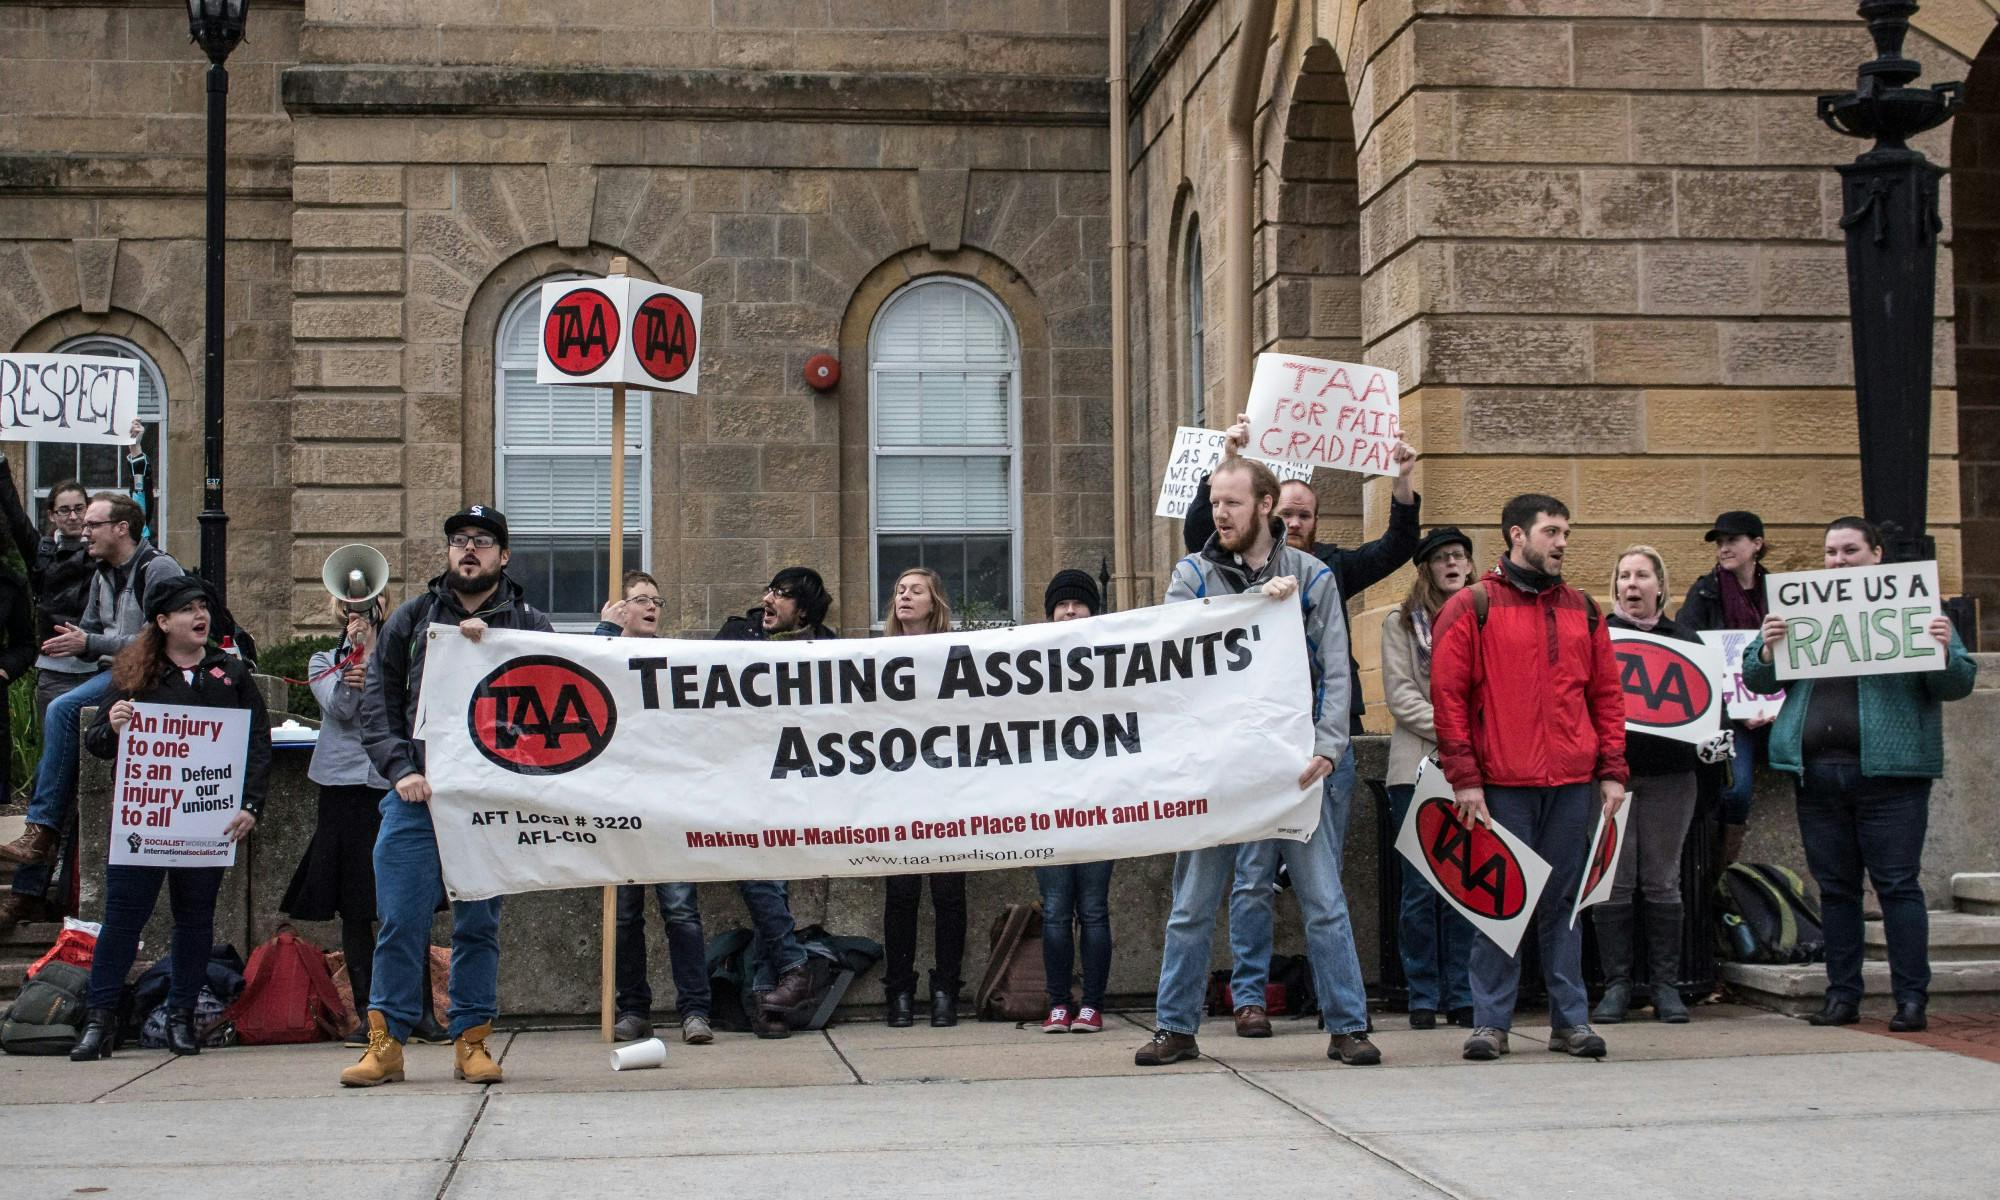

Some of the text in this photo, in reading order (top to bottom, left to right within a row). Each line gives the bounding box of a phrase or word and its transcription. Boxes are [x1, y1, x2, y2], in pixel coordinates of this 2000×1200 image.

[551, 303, 611, 359] TAA
[641, 306, 689, 367] TAA
[0, 359, 135, 437] RESPECT
[1283, 361, 1391, 406] TAA
[1272, 397, 1399, 439] FOR FAIR
[1176, 449, 1201, 465] AS
[1258, 427, 1398, 471] GRAD PAY
[1170, 467, 1188, 482] WE
[1779, 574, 1929, 606] GIVE US A
[1785, 606, 1935, 670] RAISE
[128, 711, 224, 742] An injury
[481, 683, 603, 749] TAA
[127, 735, 190, 759] to one
[124, 758, 172, 781] is an
[181, 764, 232, 783] Defend
[122, 781, 184, 810] injury
[182, 794, 234, 814] unions!
[195, 783, 220, 798] our
[121, 805, 172, 828] to all
[471, 810, 509, 826] AFT
[516, 811, 570, 827] Local
[593, 816, 643, 830] 3220
[686, 798, 1208, 849] Making UW-Madison a Great Place to Work and Learn
[518, 830, 597, 845] AFL-CIO
[848, 846, 1055, 867] www.taa-madison.org
